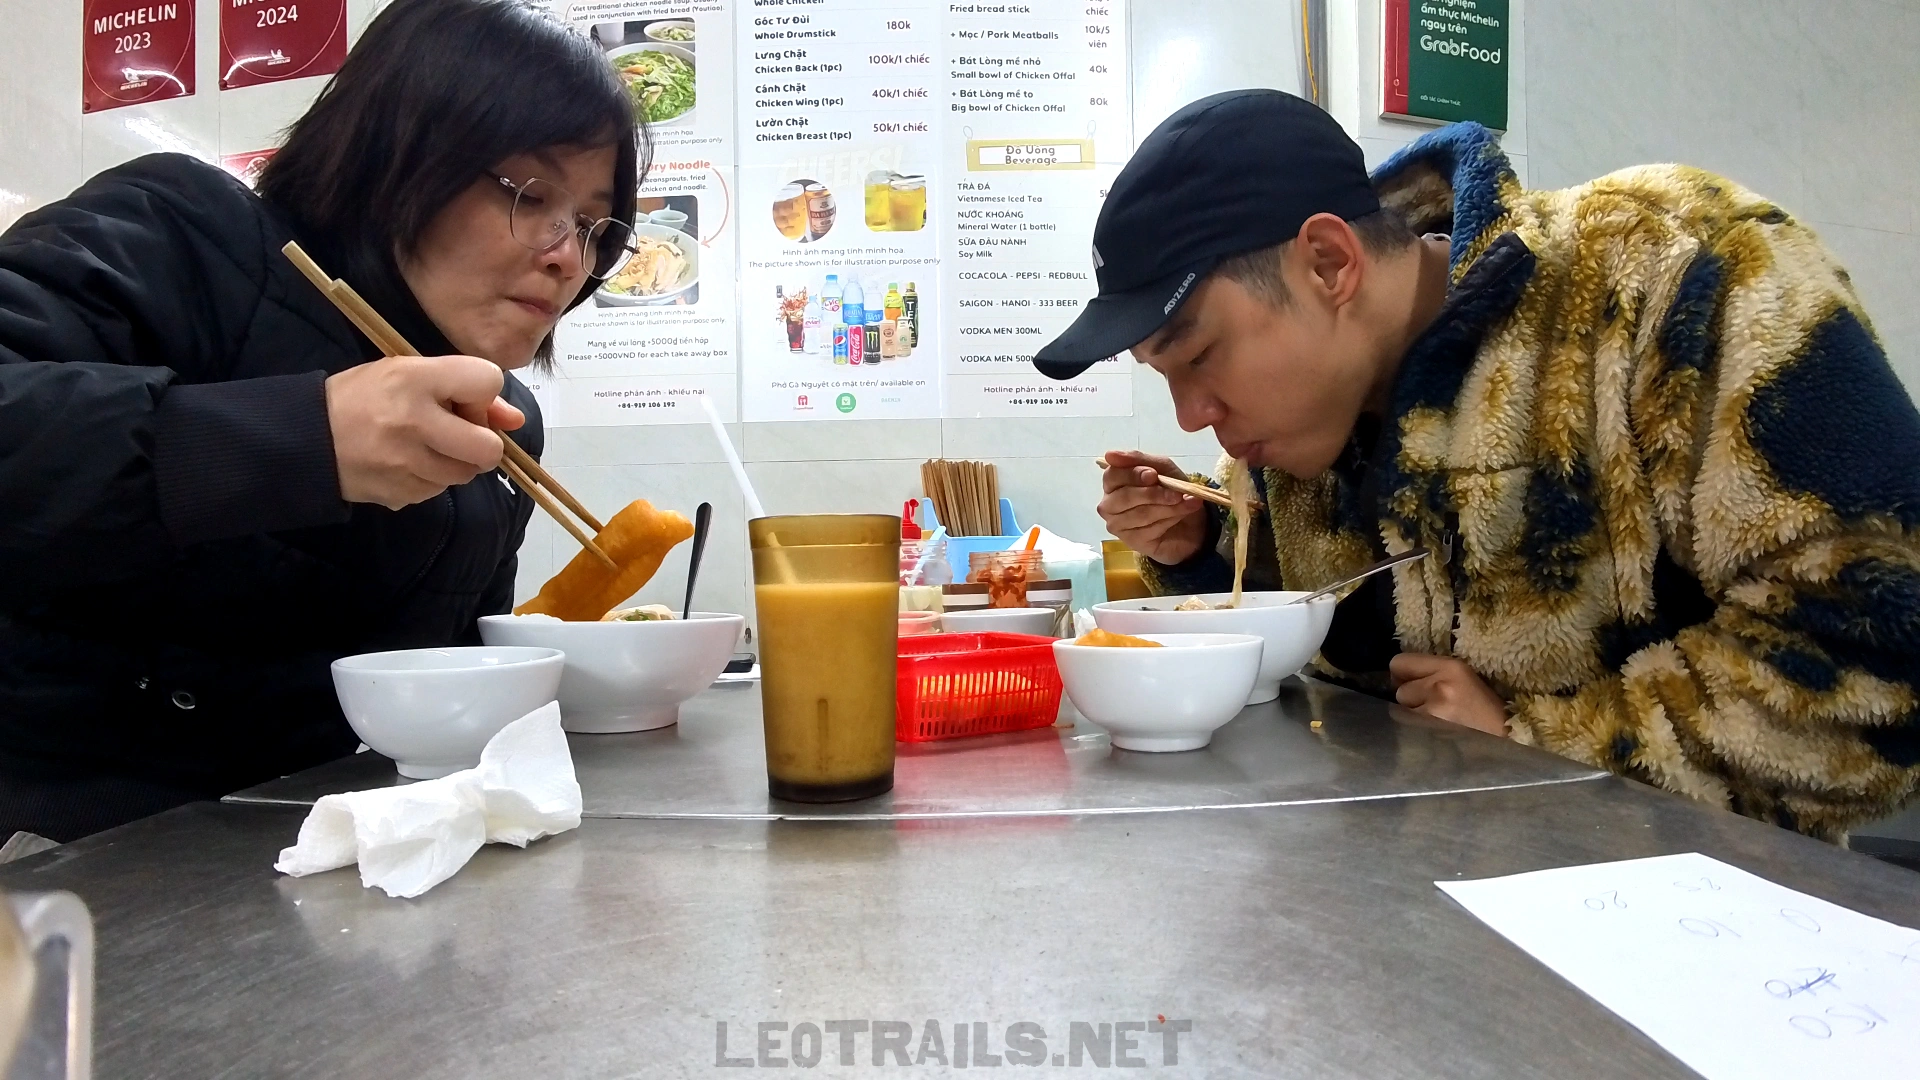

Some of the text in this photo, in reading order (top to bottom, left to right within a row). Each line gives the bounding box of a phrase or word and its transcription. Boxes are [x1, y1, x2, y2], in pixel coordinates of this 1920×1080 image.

[587, 3, 622, 11] traditional
[950, 5, 1030, 14] Fried bread stick
[1086, 6, 1108, 16] chiếc
[94, 4, 177, 35] MICHELIN
[256, 6, 298, 28] 2024
[597, 11, 635, 20] conjunction
[755, 15, 810, 26] Góc Tư Đùi
[1460, 11, 1500, 28] Michelin
[886, 20, 911, 30] 180k
[1420, 19, 1468, 34] ngay trên
[787, 29, 836, 38] Drumstick
[959, 31, 1058, 40] Mọc Pork Meatballs
[1086, 26, 1110, 35] 10k/5
[114, 32, 151, 54] 2023
[1420, 34, 1501, 64] GrabFood
[755, 52, 781, 60] Lưng
[868, 53, 930, 64] 100k/1 chiếc
[960, 56, 1002, 66] Bát Lòng
[755, 64, 842, 74] Chicken Back (1pc)
[1089, 66, 1108, 74] 40k
[951, 71, 1076, 80] Small bowl of Chicken Offal
[756, 84, 780, 94] Cánh
[872, 87, 928, 98] 40k/1 chiếc
[960, 89, 976, 98] Bát
[980, 89, 1003, 100] Lòng
[756, 98, 844, 108] Chicken Wing (1pc)
[1090, 98, 1108, 106] 80k
[952, 104, 966, 113] Big
[1006, 104, 1040, 112] Chicken
[1043, 105, 1066, 113] Offal
[756, 118, 783, 128] Lườn
[873, 122, 928, 132] 50k/1 chiếc
[756, 132, 852, 142] Chicken Breast (1pc)
[669, 160, 710, 170] Noodle
[1006, 156, 1057, 166] Beverage
[958, 182, 990, 190] TRÀ ĐÁ
[958, 210, 1024, 218] NƯỚC KHOÁNG
[1020, 223, 1027, 231] (1
[1030, 223, 1056, 231] bottle)
[958, 237, 976, 246] SỮA
[1001, 237, 1026, 246] NÀNH
[822, 248, 844, 256] mang
[958, 250, 974, 258] Soy
[765, 260, 793, 268] picture
[795, 259, 821, 267] shown
[844, 258, 886, 266] illustration
[888, 258, 921, 266] purpose
[924, 257, 940, 266] only
[1164, 272, 1196, 316] ADIZERO
[588, 340, 607, 348] Mang
[568, 353, 592, 361] Please
[594, 352, 636, 360] +5000VND
